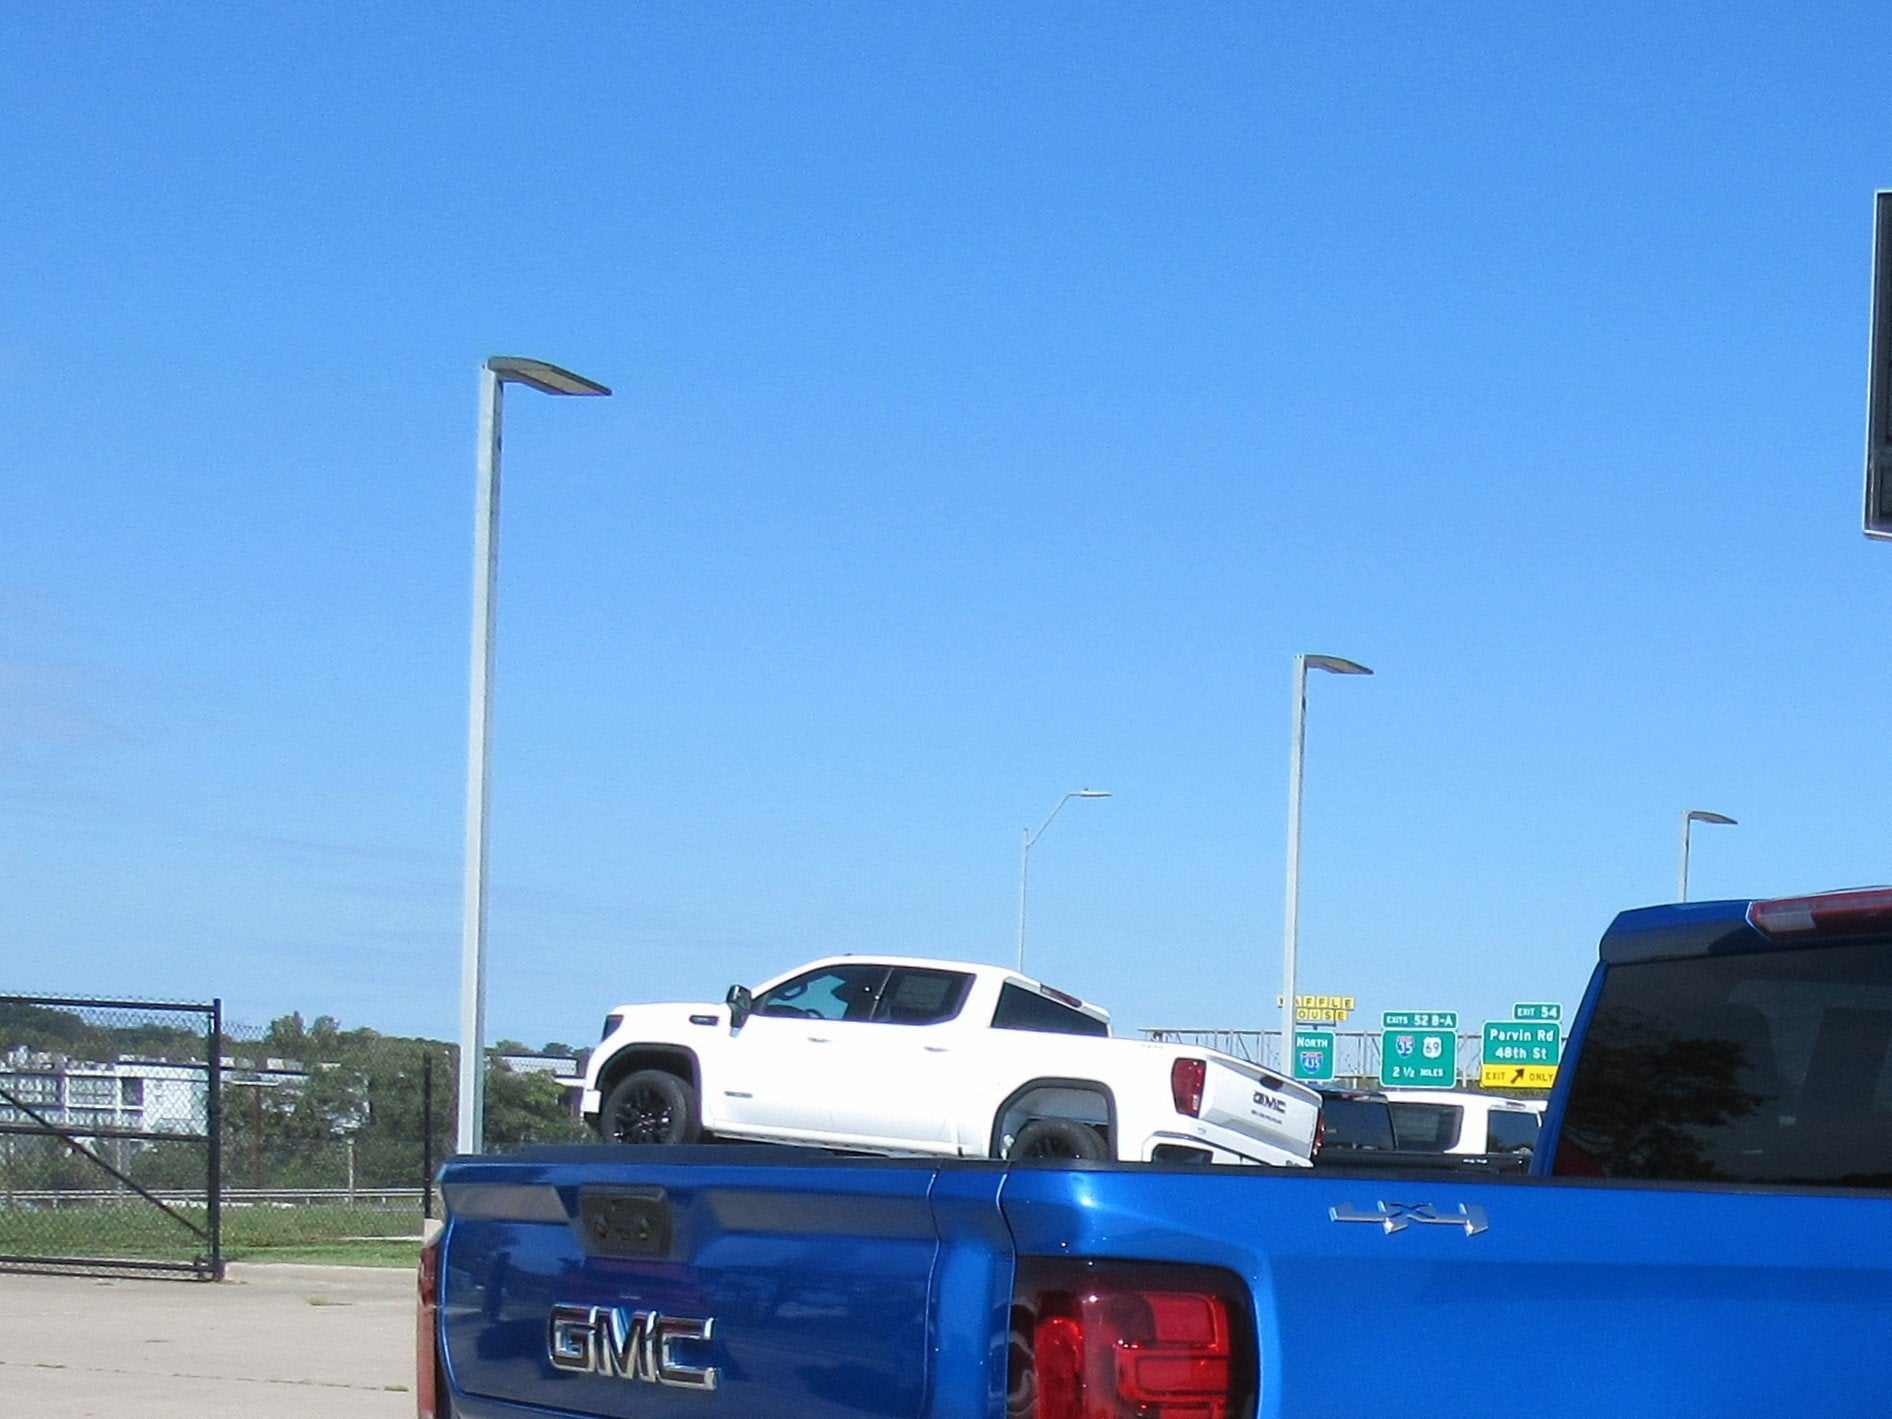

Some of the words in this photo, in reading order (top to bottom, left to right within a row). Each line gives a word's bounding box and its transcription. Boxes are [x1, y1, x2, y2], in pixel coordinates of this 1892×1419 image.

[1517, 1007, 1535, 1017] EXIT
[1541, 1006, 1557, 1018] 54
[1413, 1014, 1429, 1026] 52
[1489, 1028, 1532, 1041] Parvin
[1537, 1029, 1555, 1042] Rd
[1296, 1036, 1329, 1048] NORTH
[1425, 1041, 1440, 1054] 69
[1494, 1046, 1528, 1059] 48th
[1532, 1046, 1547, 1060] St
[1485, 1071, 1506, 1081] EXIT
[1528, 1072, 1555, 1082] ONLY
[548, 1302, 720, 1391] GMC
